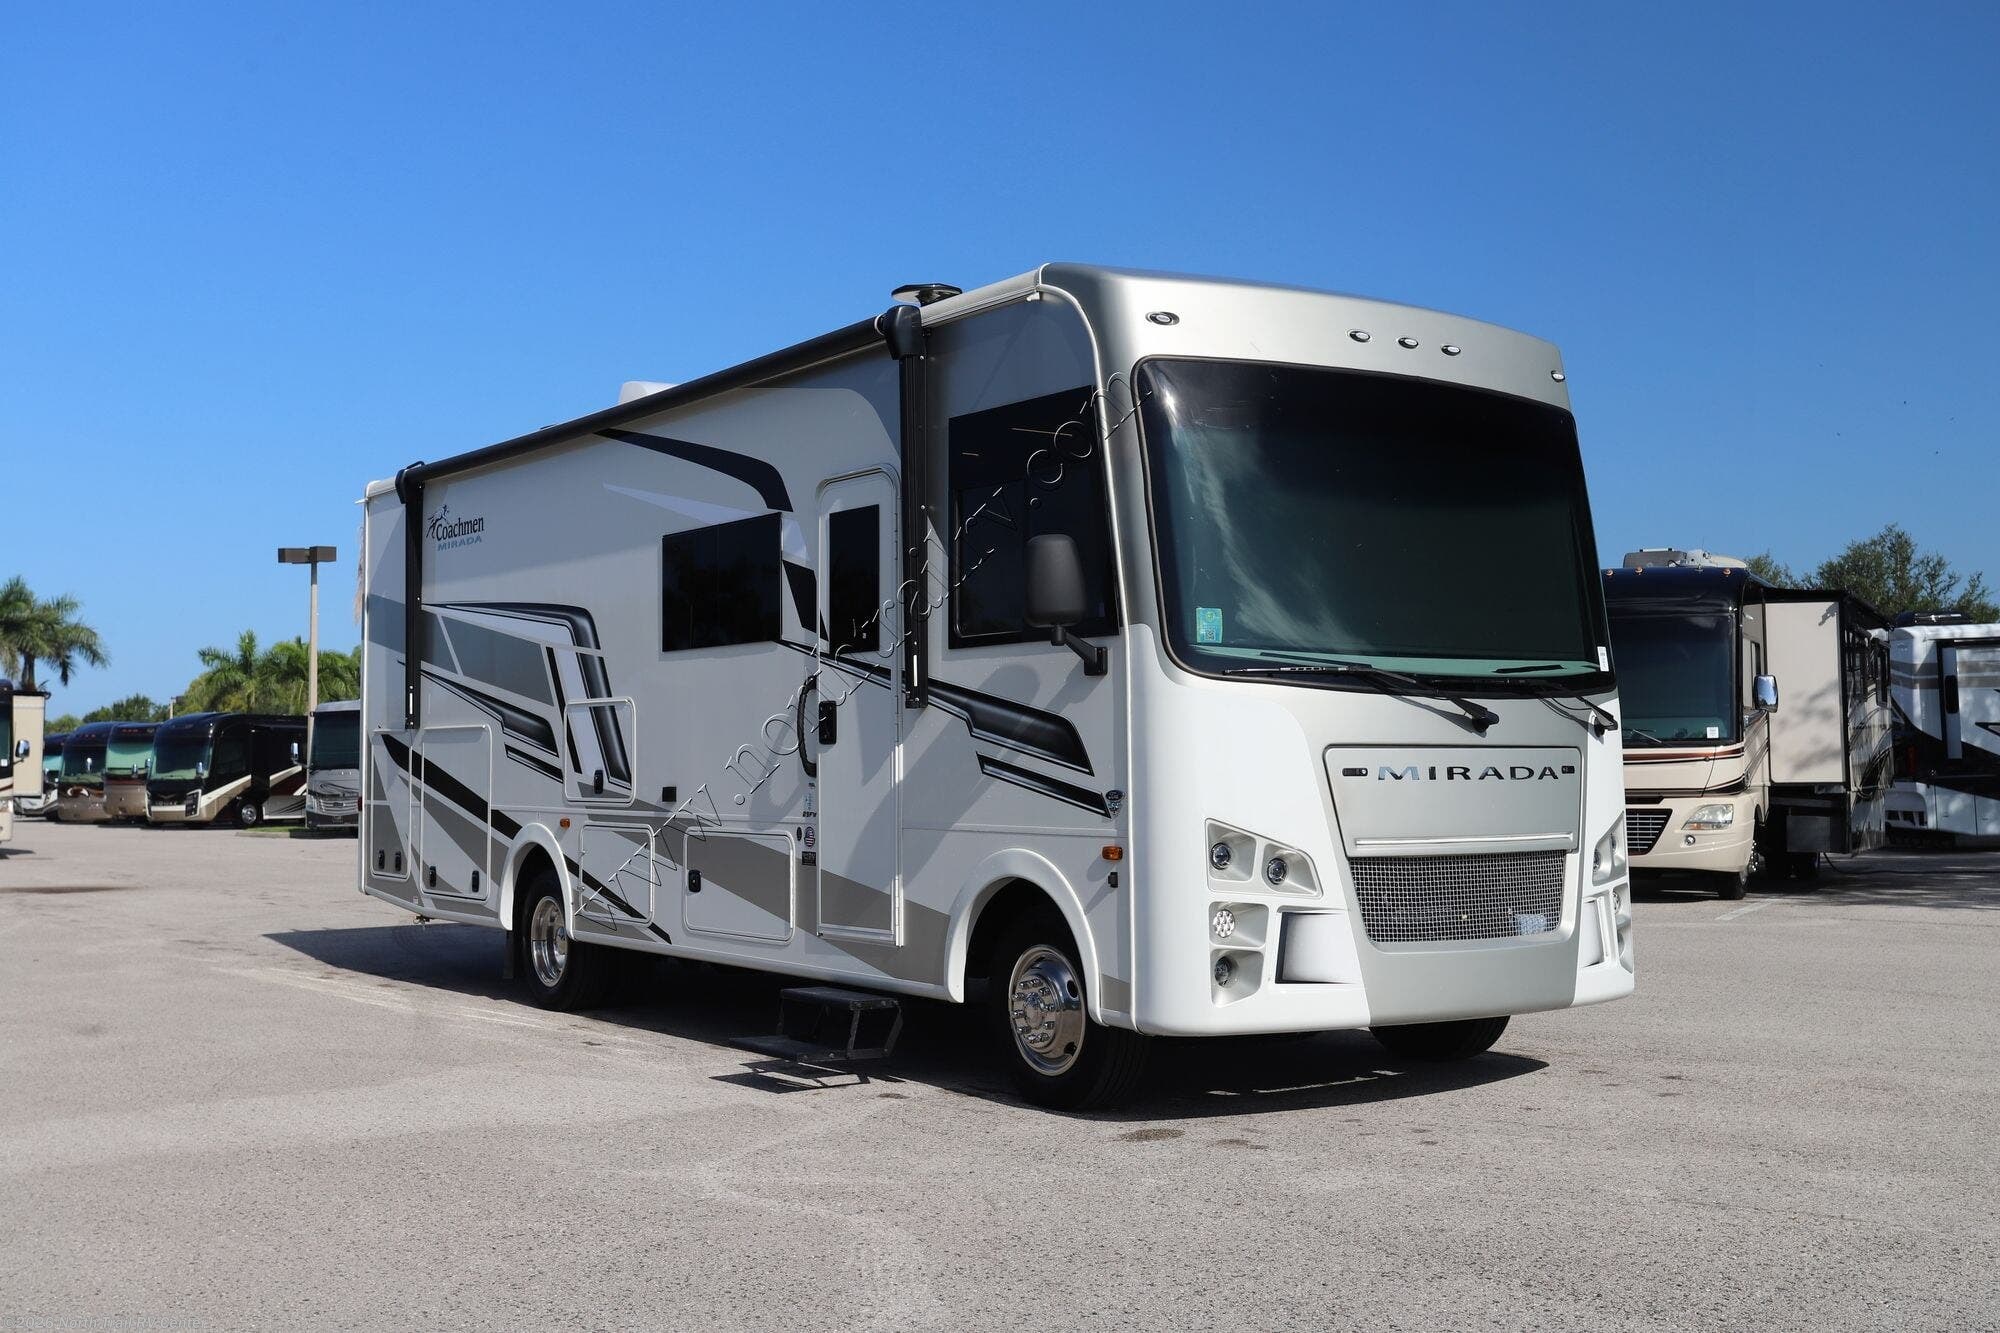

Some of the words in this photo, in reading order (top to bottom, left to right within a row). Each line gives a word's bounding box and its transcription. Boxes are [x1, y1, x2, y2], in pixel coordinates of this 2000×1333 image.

[436, 516, 484, 541] Coachmen
[437, 535, 482, 552] MIRADA
[1377, 766, 1559, 781] MIRADA
